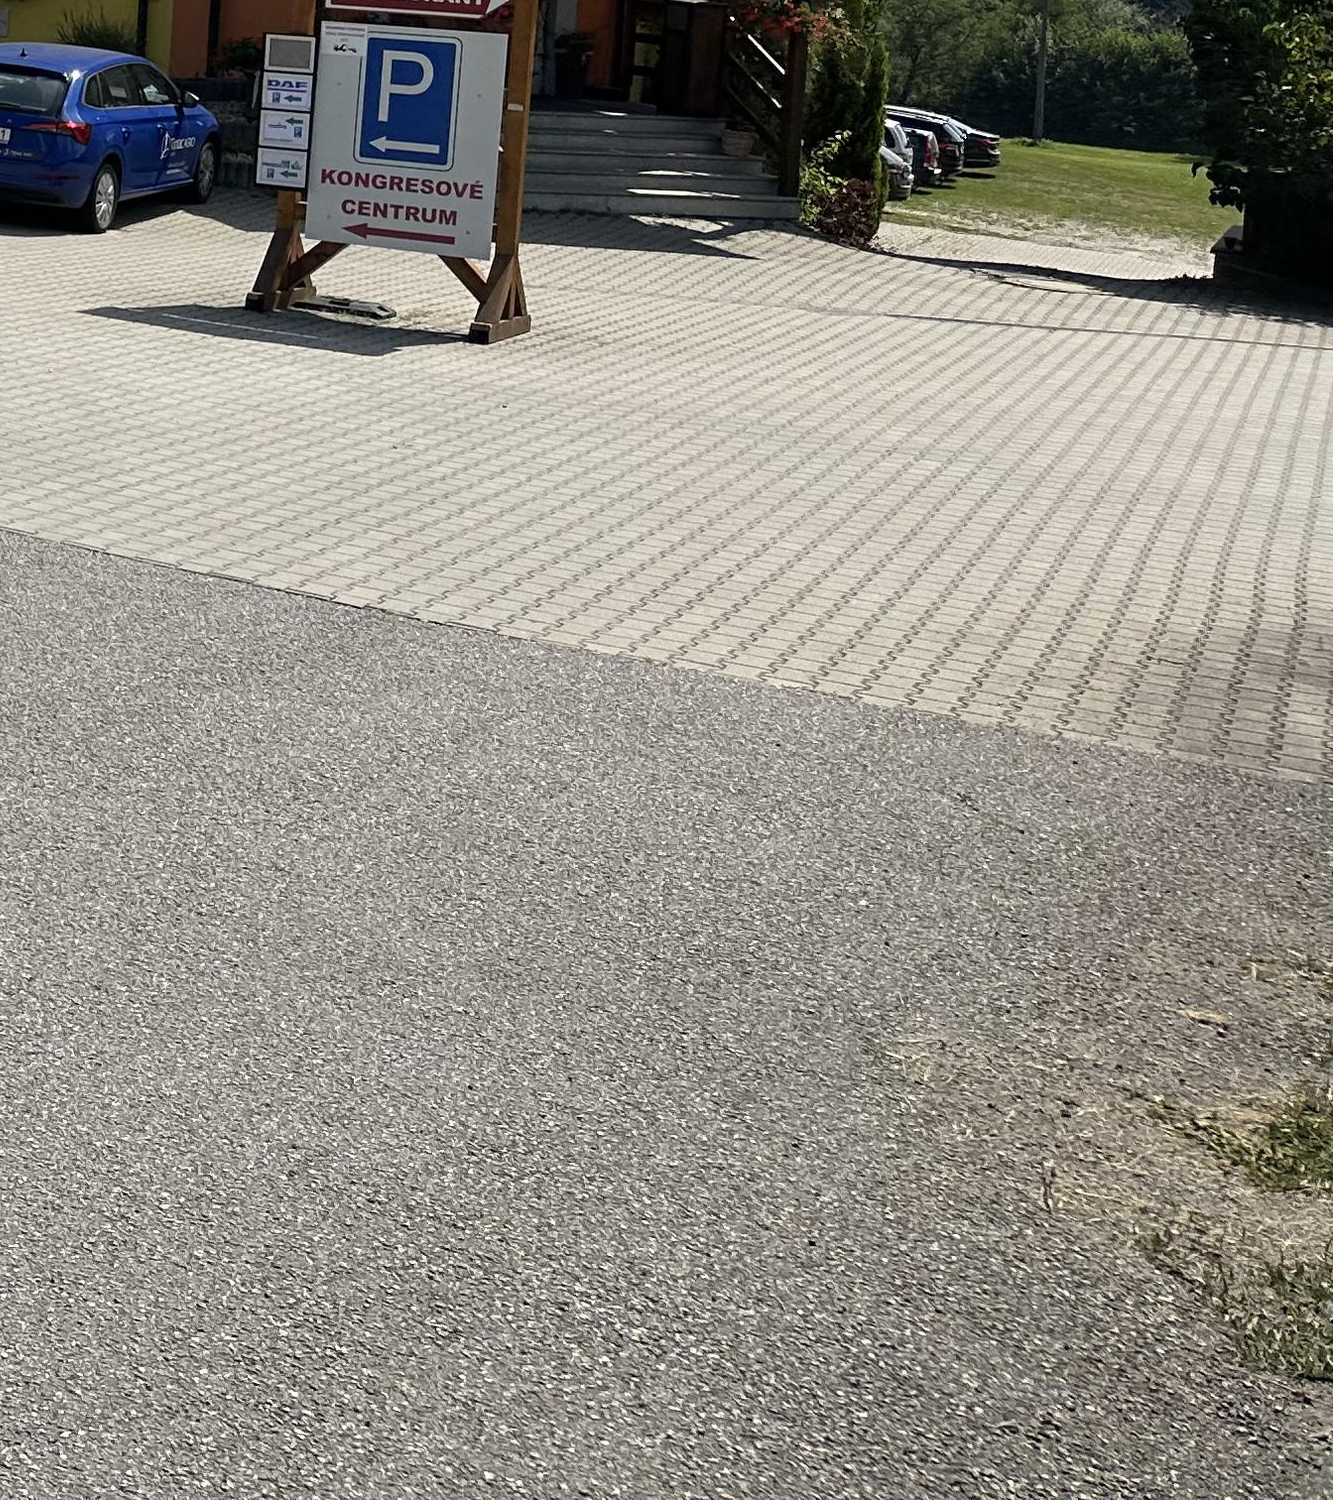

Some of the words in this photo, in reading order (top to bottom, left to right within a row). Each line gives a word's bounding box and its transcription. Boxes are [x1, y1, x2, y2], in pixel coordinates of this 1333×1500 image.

[267, 79, 308, 89] DAF
[378, 50, 434, 122] P
[320, 168, 484, 200] KONGRESOVÉ
[341, 199, 458, 227] CENTRUM
